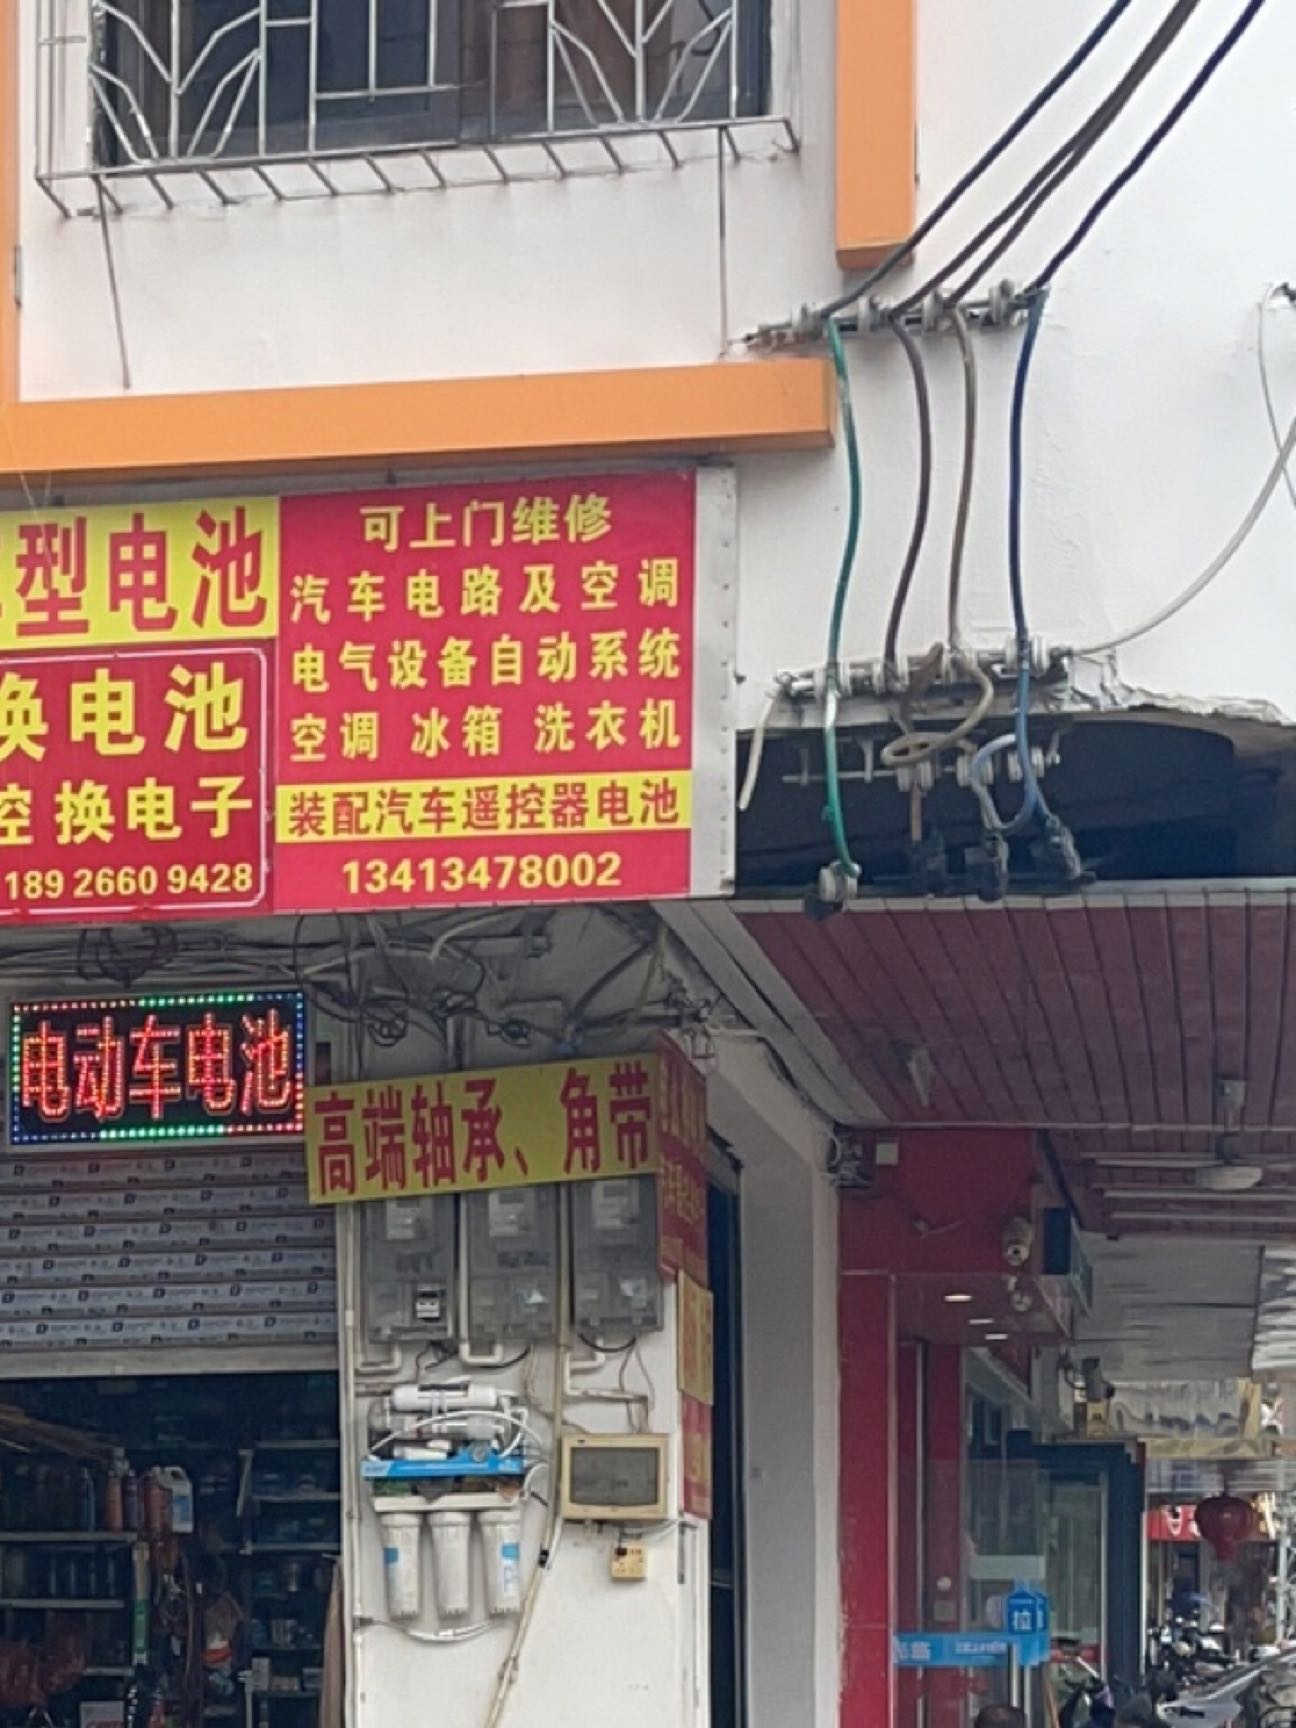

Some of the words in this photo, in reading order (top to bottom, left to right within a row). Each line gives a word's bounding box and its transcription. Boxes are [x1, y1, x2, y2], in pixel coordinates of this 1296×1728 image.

[359, 493, 612, 552] 可上门维修
[289, 557, 679, 624] 汽车电路及空调
[292, 628, 682, 693] 电气设备自动系统
[290, 712, 380, 762] 空调
[410, 705, 503, 758] 冰箱
[534, 698, 682, 753] 洗衣机
[54, 775, 254, 845] 换电子
[288, 776, 680, 838] 装配汽车遥控器电池
[5, 871, 64, 900] 189
[73, 867, 157, 897] 2660
[167, 863, 253, 893] 9428
[343, 851, 622, 895] 13413478002
[20, 1008, 296, 1121] 电动车电池
